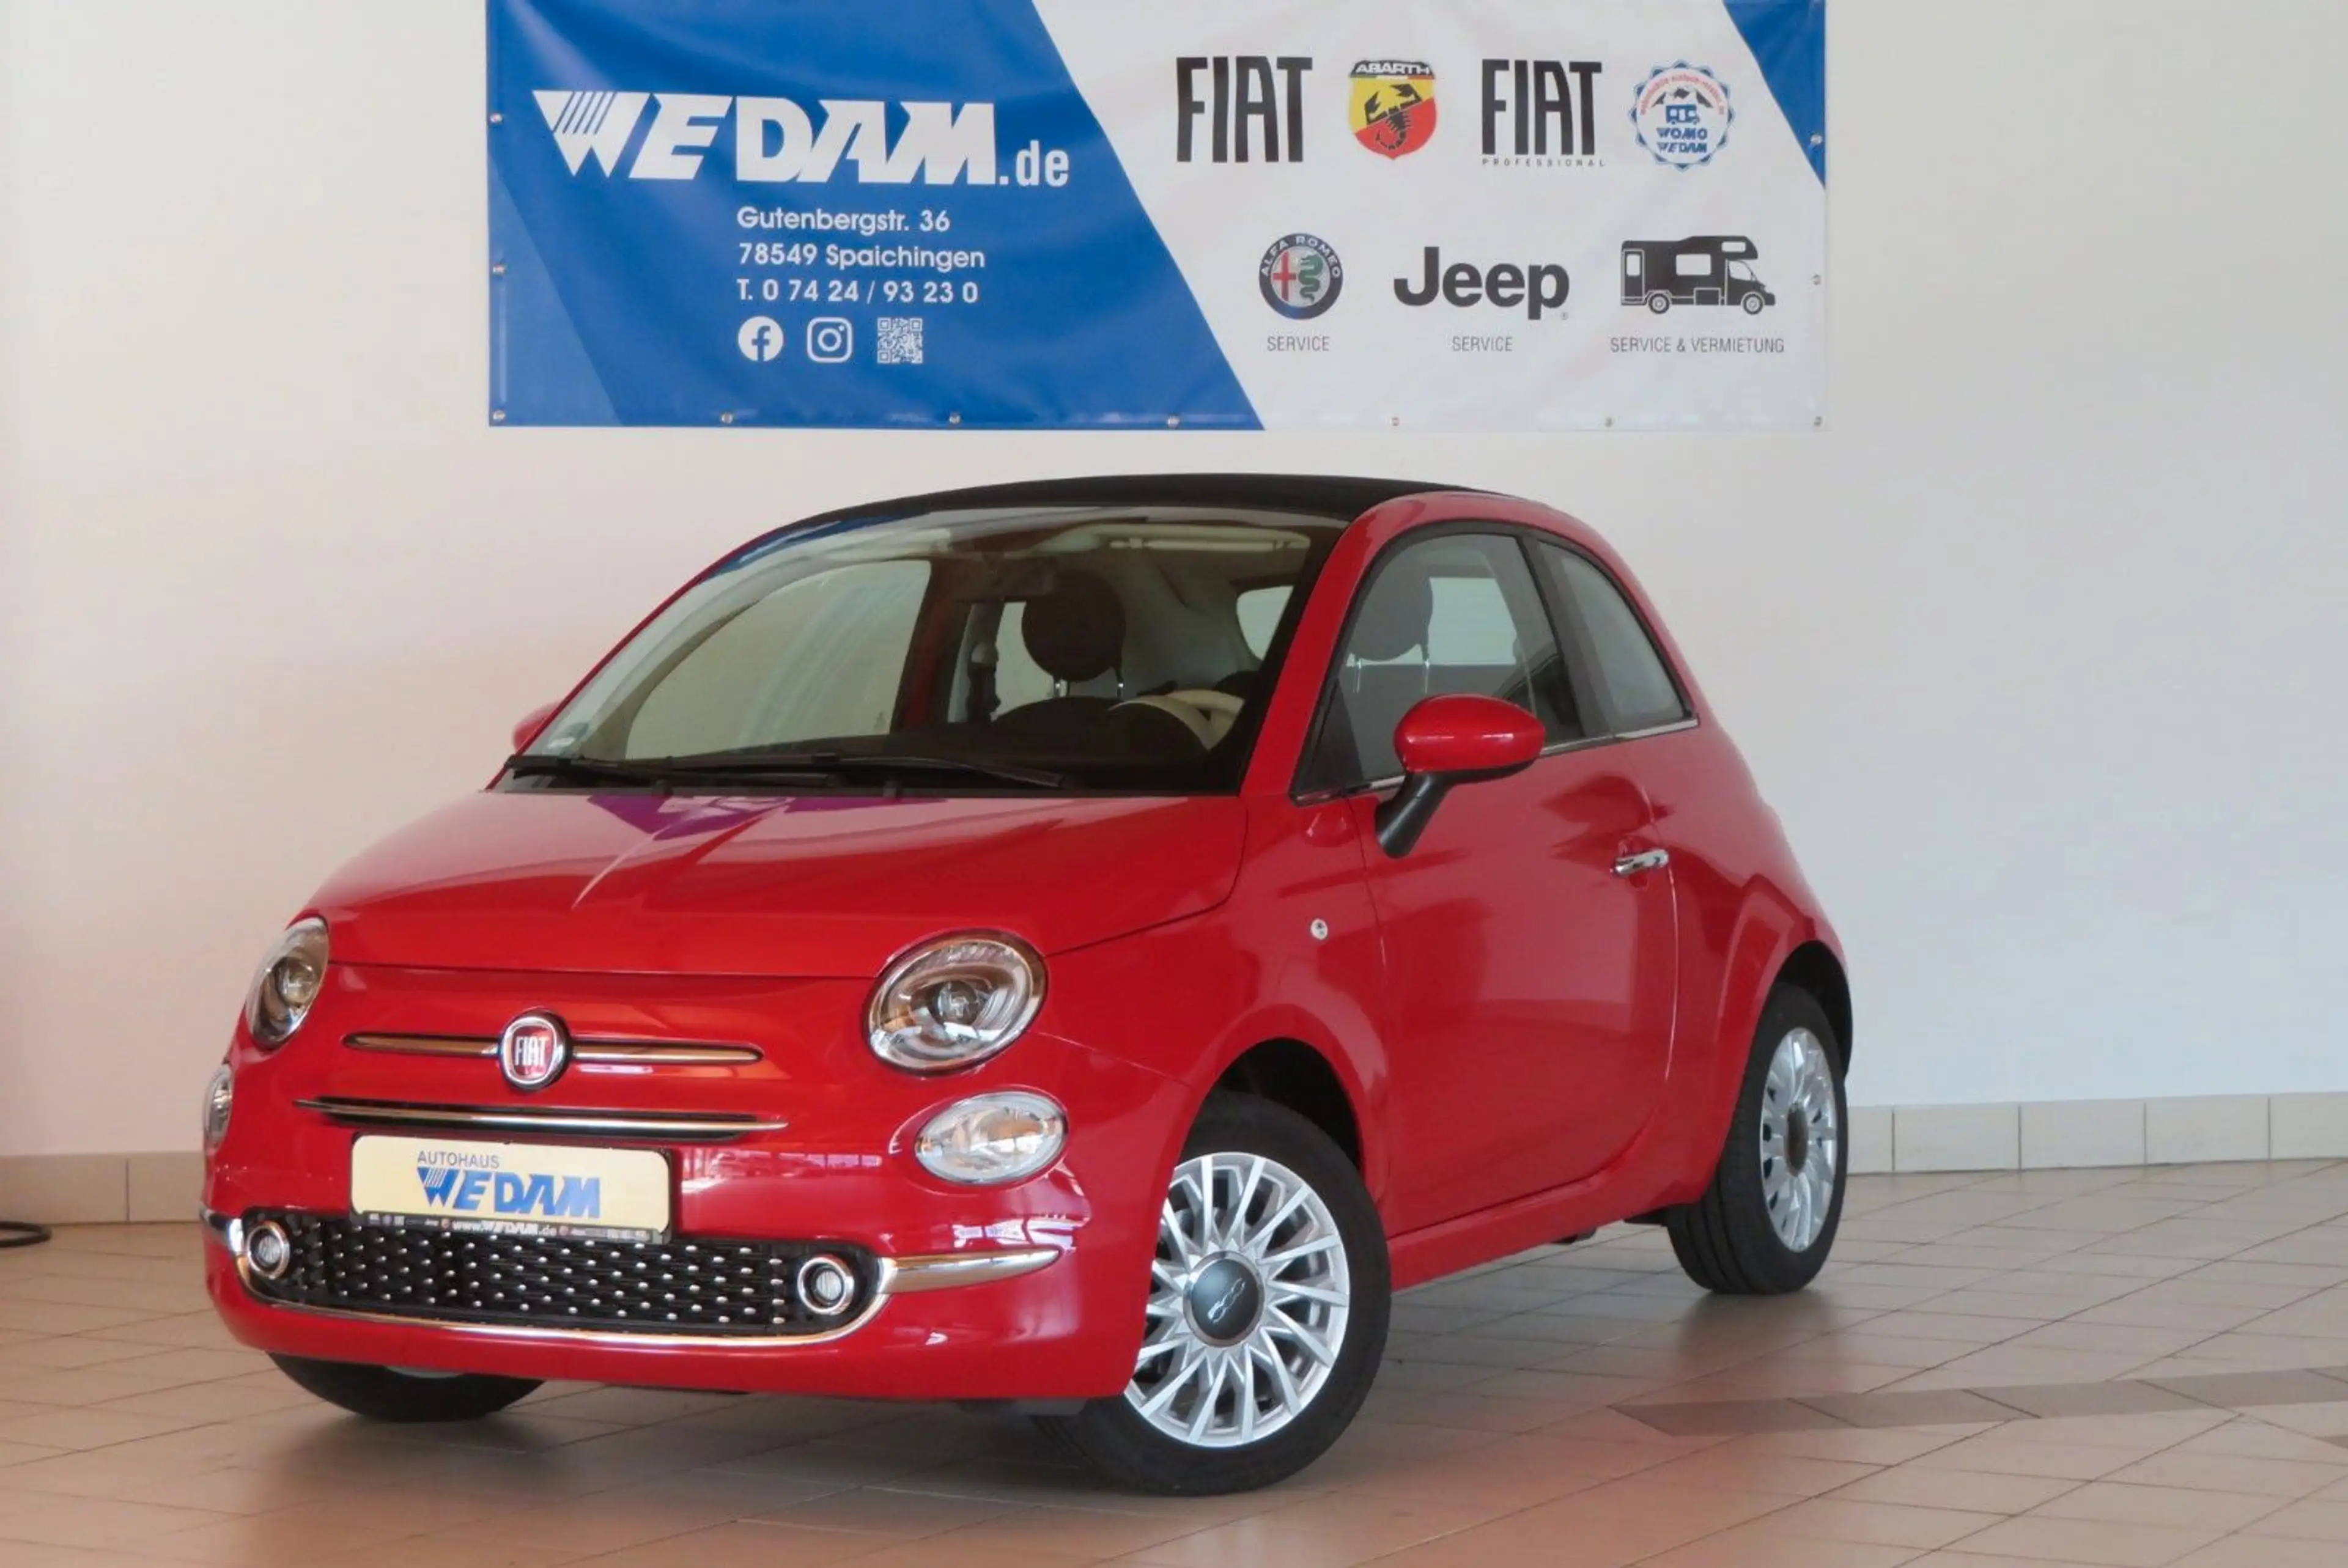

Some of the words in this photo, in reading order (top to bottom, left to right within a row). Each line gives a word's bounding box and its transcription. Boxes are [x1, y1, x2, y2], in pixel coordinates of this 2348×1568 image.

[1355, 62, 1430, 75] ABARTH
[1176, 55, 1313, 163] FIAT
[1480, 59, 1603, 156] FIAT
[1656, 127, 1708, 140] WOMO
[1656, 142, 1708, 153] WEDAM
[1482, 157, 1606, 167] PROFESSIONAL
[737, 206, 909, 236] Gutenbergstr.
[920, 209, 950, 232] 36
[739, 243, 818, 265] 78549
[825, 244, 986, 273] Spaichingen
[1261, 240, 1290, 278] ALFA
[1295, 235, 1342, 279] ROMEO
[736, 278, 753, 301] T.
[762, 279, 779, 301] 0
[789, 279, 819, 301] 74
[828, 280, 859, 302] 24
[884, 281, 914, 303] 93
[923, 281, 954, 303] 23
[962, 282, 978, 304] 0
[1394, 246, 1570, 320] Jeep
[1267, 336, 1331, 352] SERVICE
[1452, 336, 1513, 352] SERVICE
[1611, 337, 1672, 353] SERVICE
[1676, 337, 1686, 353] &
[1691, 337, 1785, 353] VERMIETUNG
[514, 1036, 551, 1066] FIAT
[416, 1150, 500, 1169] AUTOHAUS
[416, 1166, 600, 1220] WEDAM
